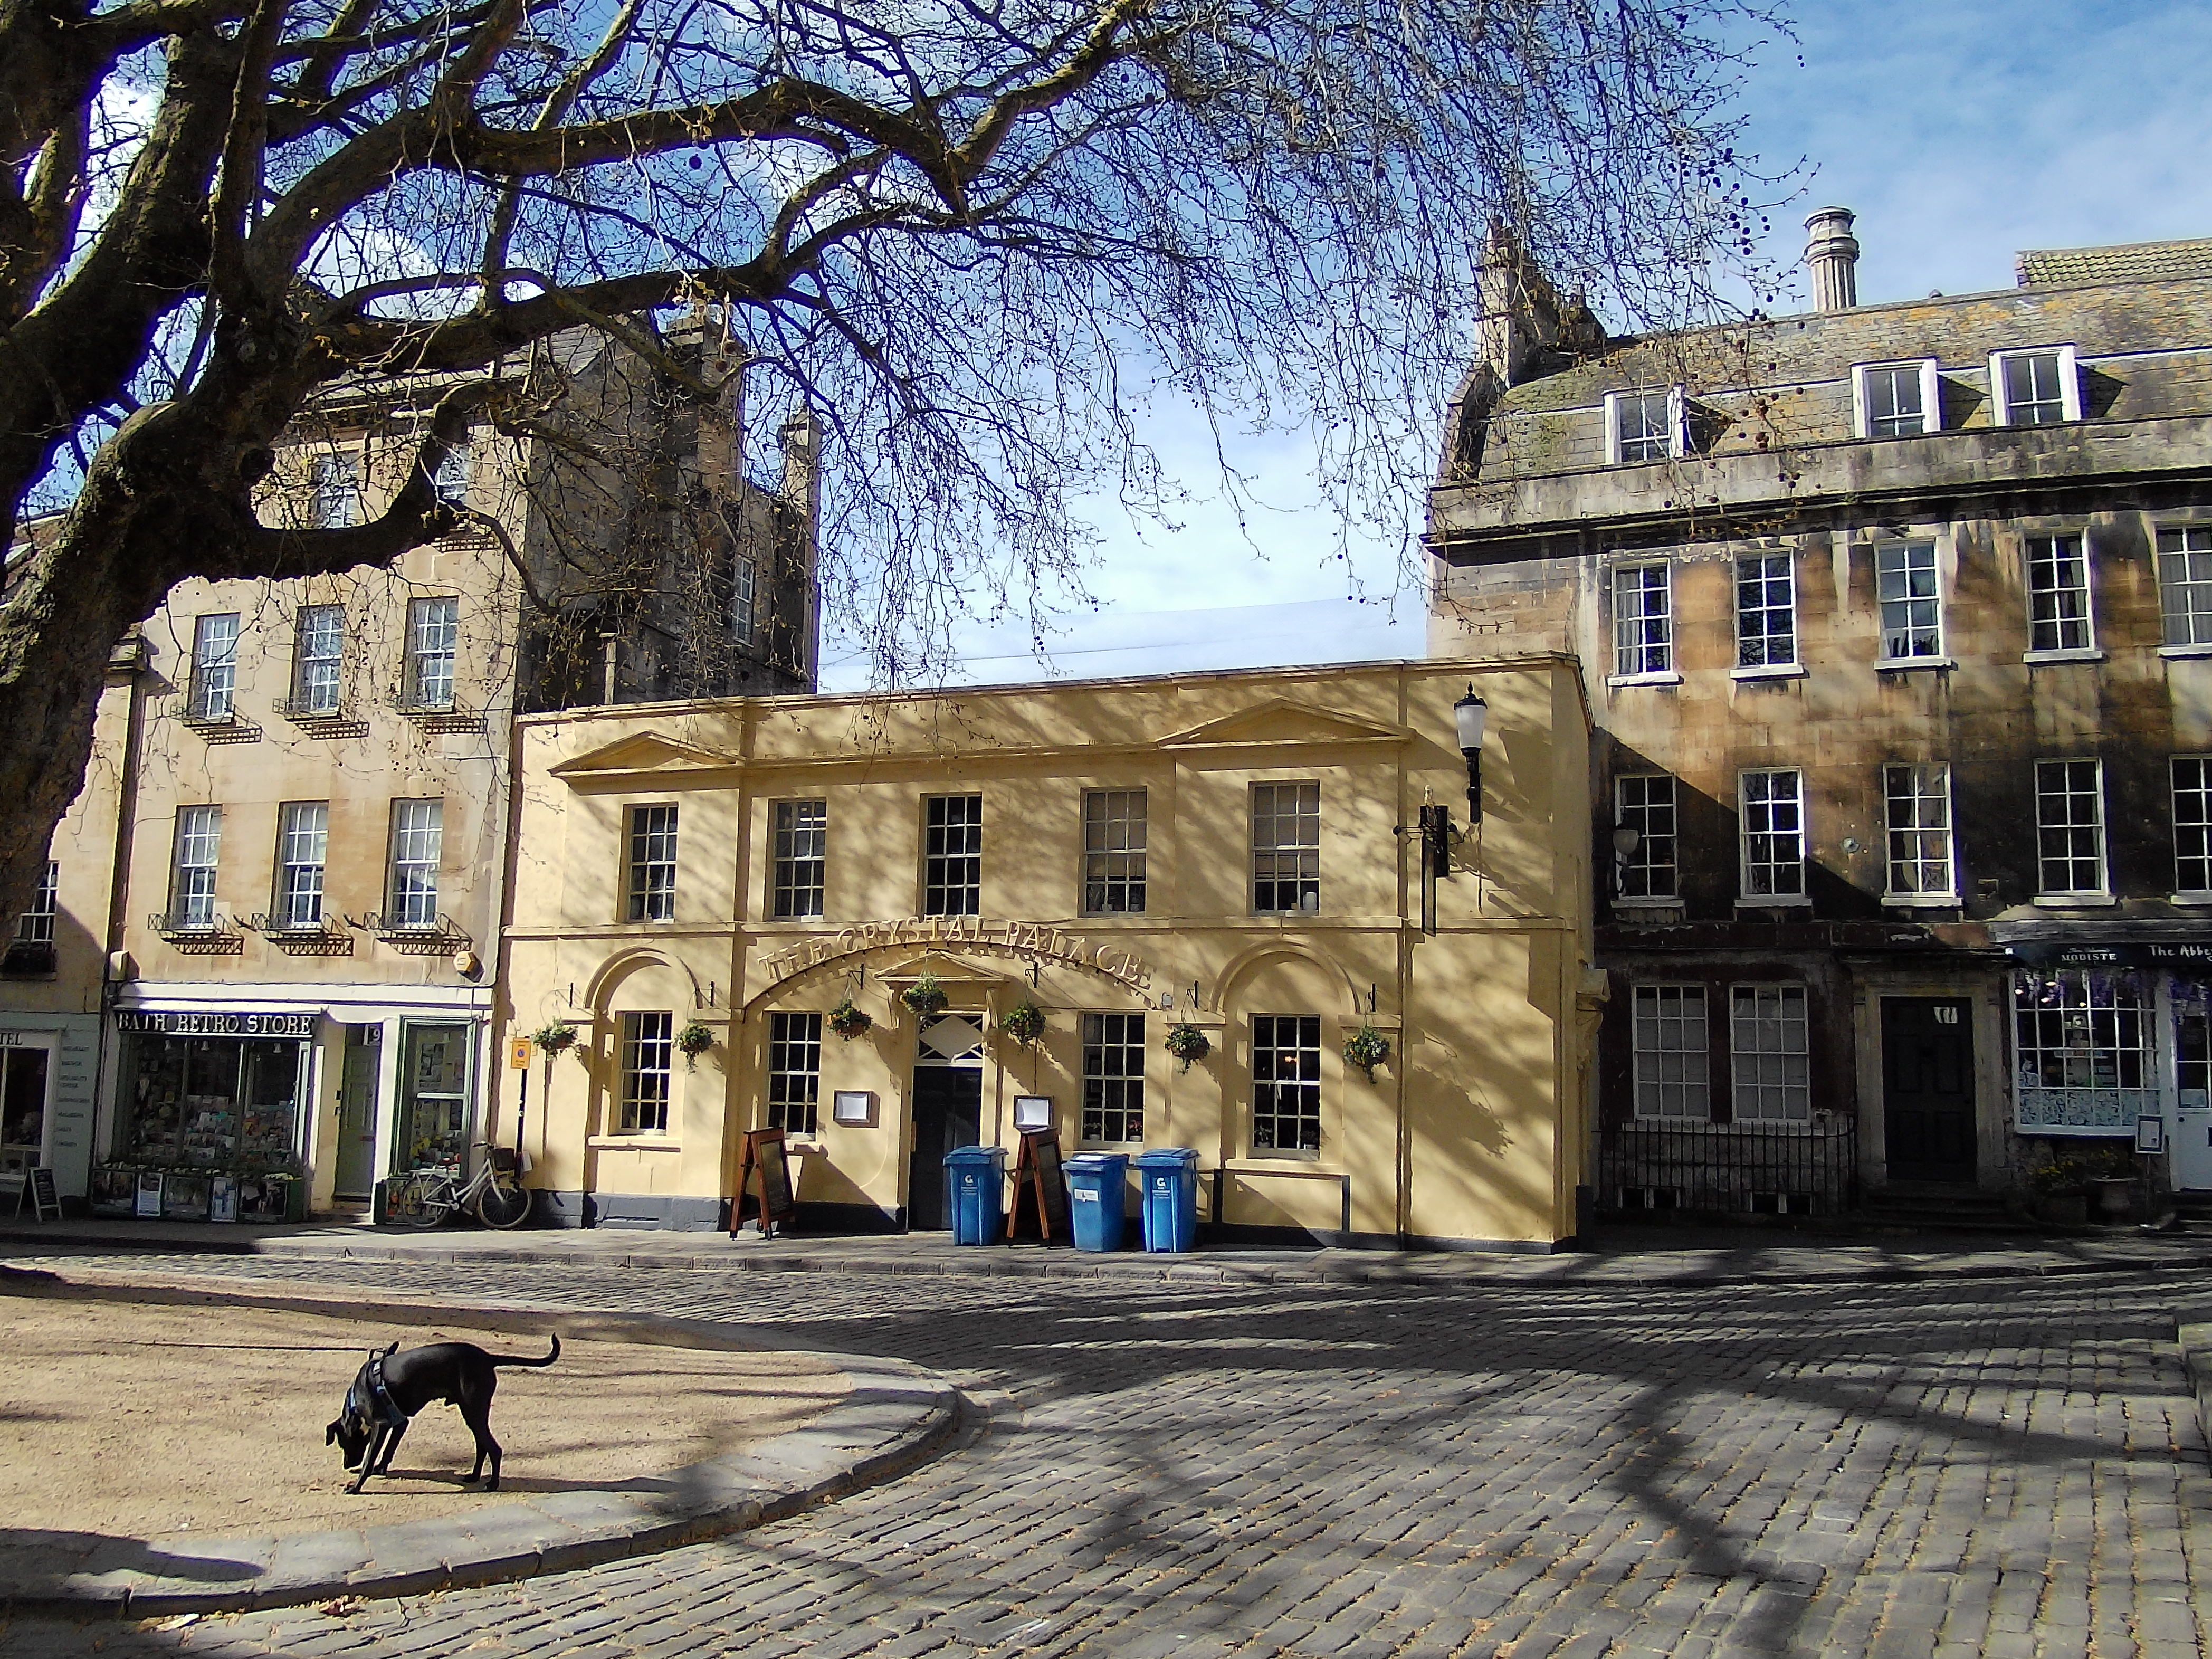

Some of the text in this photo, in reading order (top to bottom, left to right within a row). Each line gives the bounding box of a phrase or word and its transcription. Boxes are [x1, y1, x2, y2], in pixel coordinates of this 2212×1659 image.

[757, 914, 1145, 982] THE CRYSTAL PALACE
[2148, 945, 2175, 956] The
[2061, 953, 2118, 961] MODISTE
[118, 1013, 312, 1034] BATH RETRO STORE
